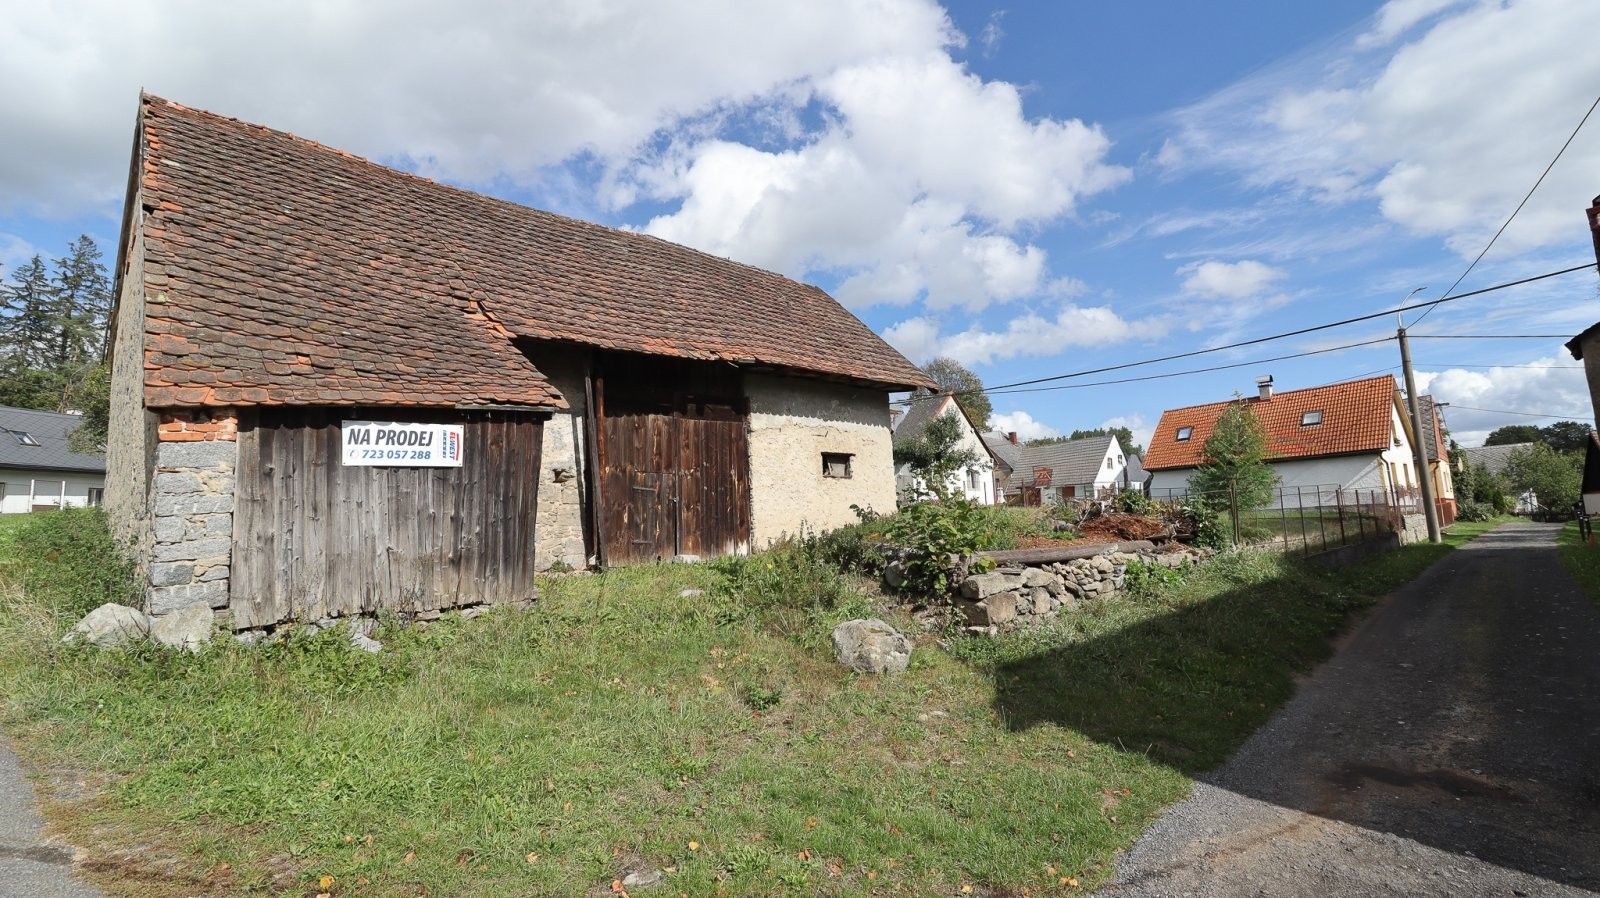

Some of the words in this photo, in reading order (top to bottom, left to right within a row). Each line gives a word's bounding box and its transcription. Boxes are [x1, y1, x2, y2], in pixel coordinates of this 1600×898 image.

[347, 428, 371, 445] NA
[375, 429, 434, 446] PRODEJ
[362, 449, 384, 459] 723
[387, 450, 408, 460] 057
[410, 450, 431, 460] 288
